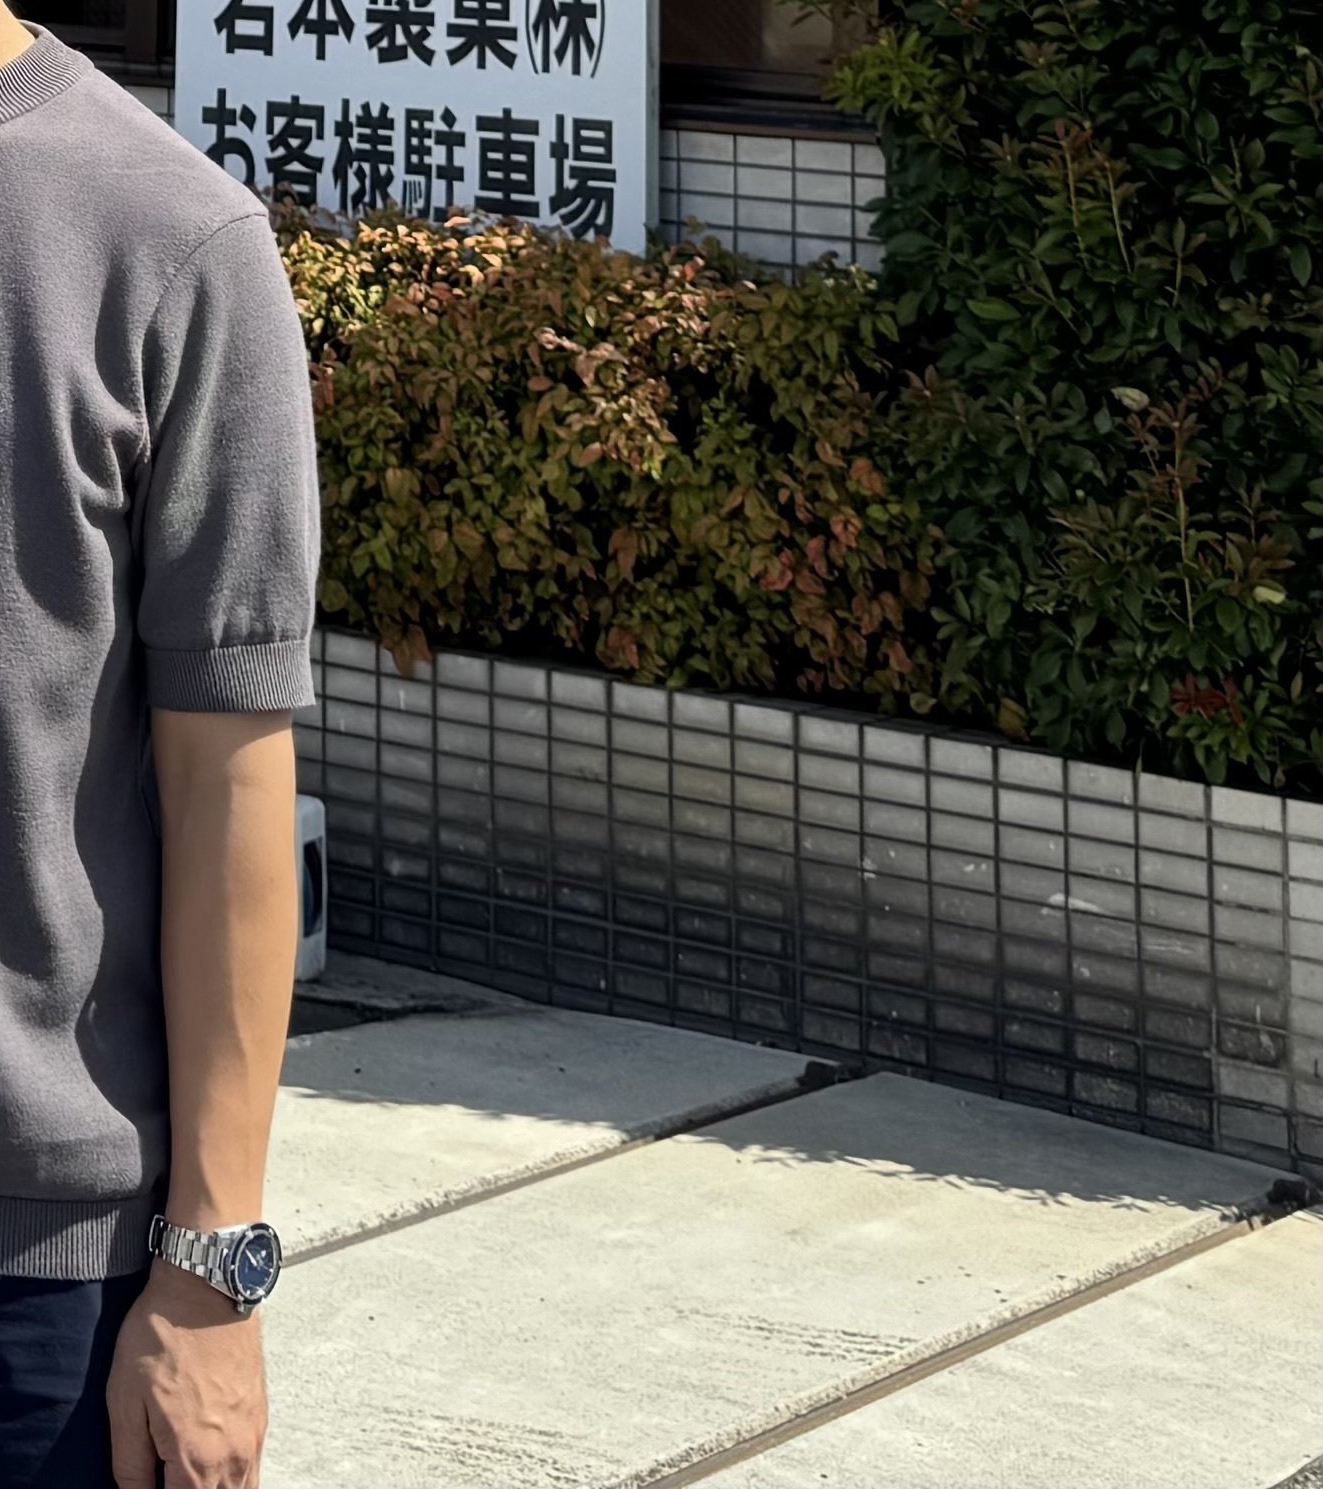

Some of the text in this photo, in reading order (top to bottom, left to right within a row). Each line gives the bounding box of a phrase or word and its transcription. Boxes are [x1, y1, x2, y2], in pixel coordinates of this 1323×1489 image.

[202, 88, 617, 239] お客様駐車場
